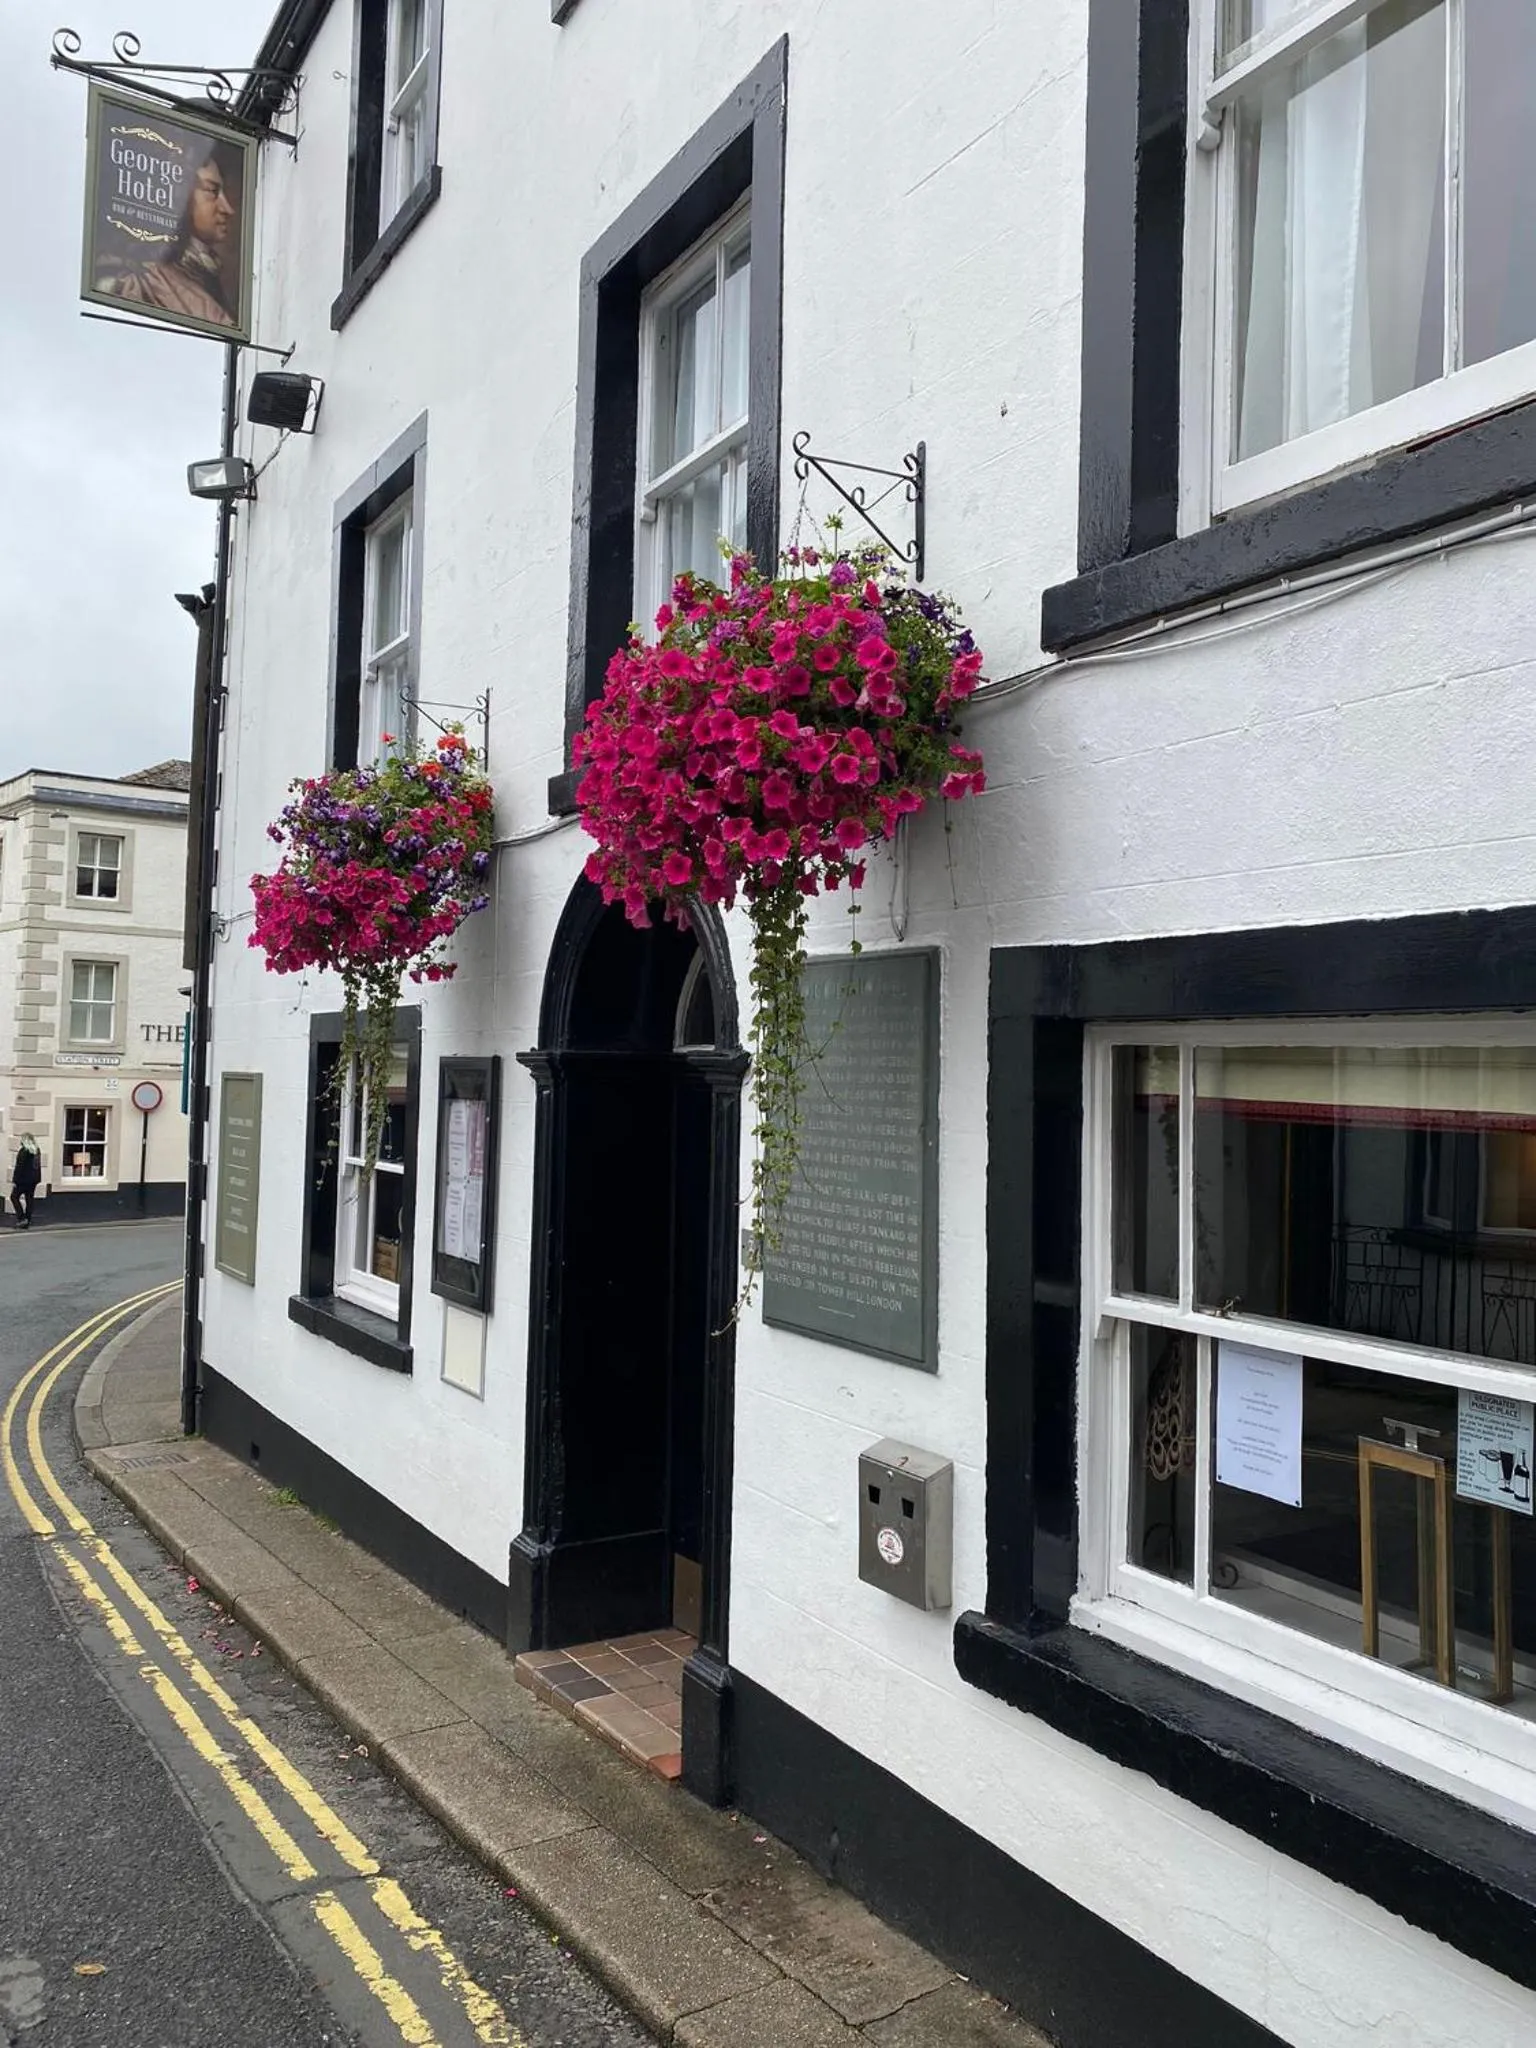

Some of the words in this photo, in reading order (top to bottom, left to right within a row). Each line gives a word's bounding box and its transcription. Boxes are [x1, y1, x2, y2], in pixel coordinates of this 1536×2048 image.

[110, 139, 183, 186] George
[118, 169, 173, 209] Hotel
[140, 1024, 186, 1042] THE
[817, 1282, 843, 1298] TOWER
[881, 1279, 895, 1293] ON
[898, 1282, 918, 1299] THE
[1472, 1401, 1494, 1411] PUBLIC
[1496, 1406, 1517, 1417] PLACE
